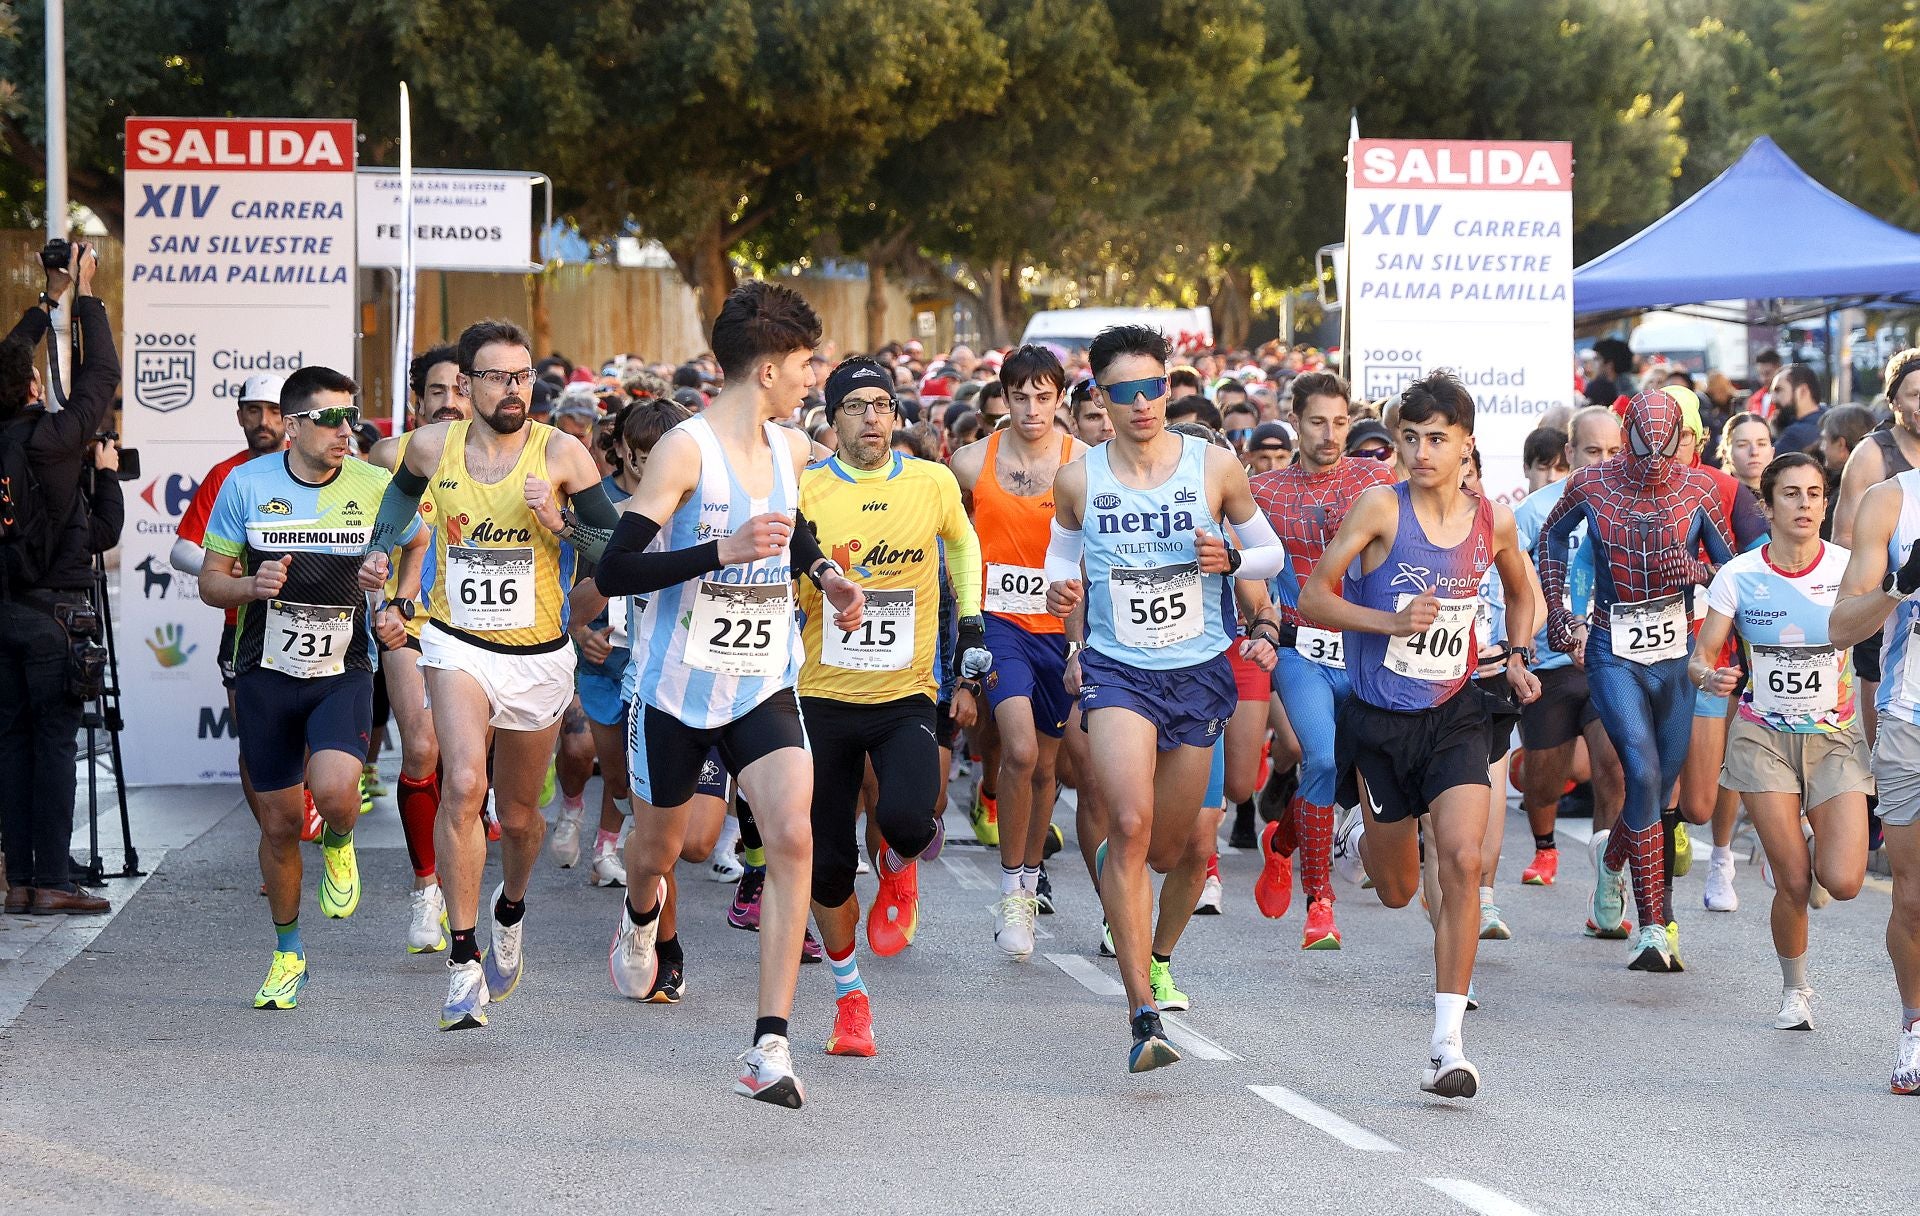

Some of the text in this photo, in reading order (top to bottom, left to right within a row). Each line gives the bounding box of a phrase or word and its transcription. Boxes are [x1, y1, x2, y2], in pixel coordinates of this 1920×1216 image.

[137, 128, 344, 166] SALIDA
[1363, 148, 1561, 185] SALIDA
[136, 184, 344, 219] XIV CARRERA
[376, 224, 502, 240] FEERADOS
[1361, 202, 1562, 238] XIV CARRERA
[149, 235, 334, 255] SAN SILVESTRE
[132, 264, 348, 284] PALMA PALMILLA
[1376, 252, 1552, 272] SAN SILVESTRE
[1360, 281, 1567, 301] PALMA PALMILLA
[213, 350, 303, 370] Ciudad
[213, 379, 241, 398] de
[1094, 495, 1121, 508] TROPS
[1174, 486, 1197, 502] als
[471, 517, 531, 542] Álora
[1097, 504, 1195, 539] nerja
[262, 531, 365, 544] TORREMOLINOS
[1114, 541, 1183, 554] ATLETISMO
[861, 539, 925, 567] Álora
[460, 578, 518, 605] 616
[1001, 573, 1044, 596] 602
[1130, 592, 1187, 625] 565
[1745, 609, 1787, 618] Málaga
[709, 617, 771, 649] 225
[1745, 617, 1773, 626] 2025
[281, 628, 333, 658] 731
[1406, 626, 1466, 658] 406
[1628, 620, 1676, 650] 255
[1310, 638, 1345, 662] 31
[1768, 670, 1822, 694] 654
